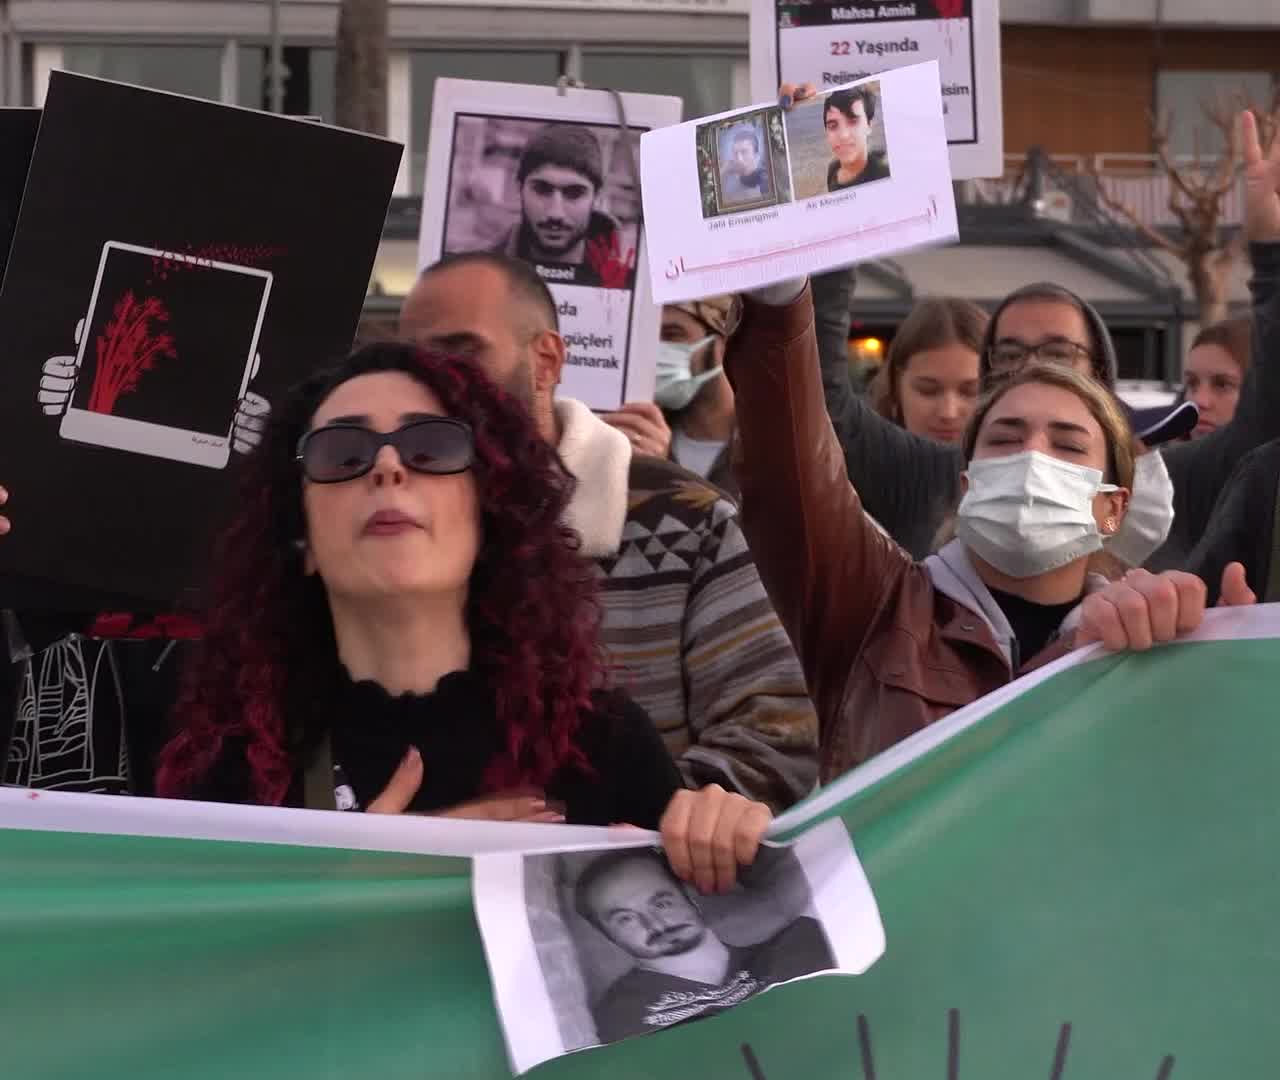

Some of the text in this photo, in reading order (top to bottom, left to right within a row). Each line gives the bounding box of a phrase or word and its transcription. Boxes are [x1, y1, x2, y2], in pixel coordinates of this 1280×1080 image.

[831, 4, 916, 20] Mahsa Amini
[830, 37, 919, 57] 22 Yaşında
